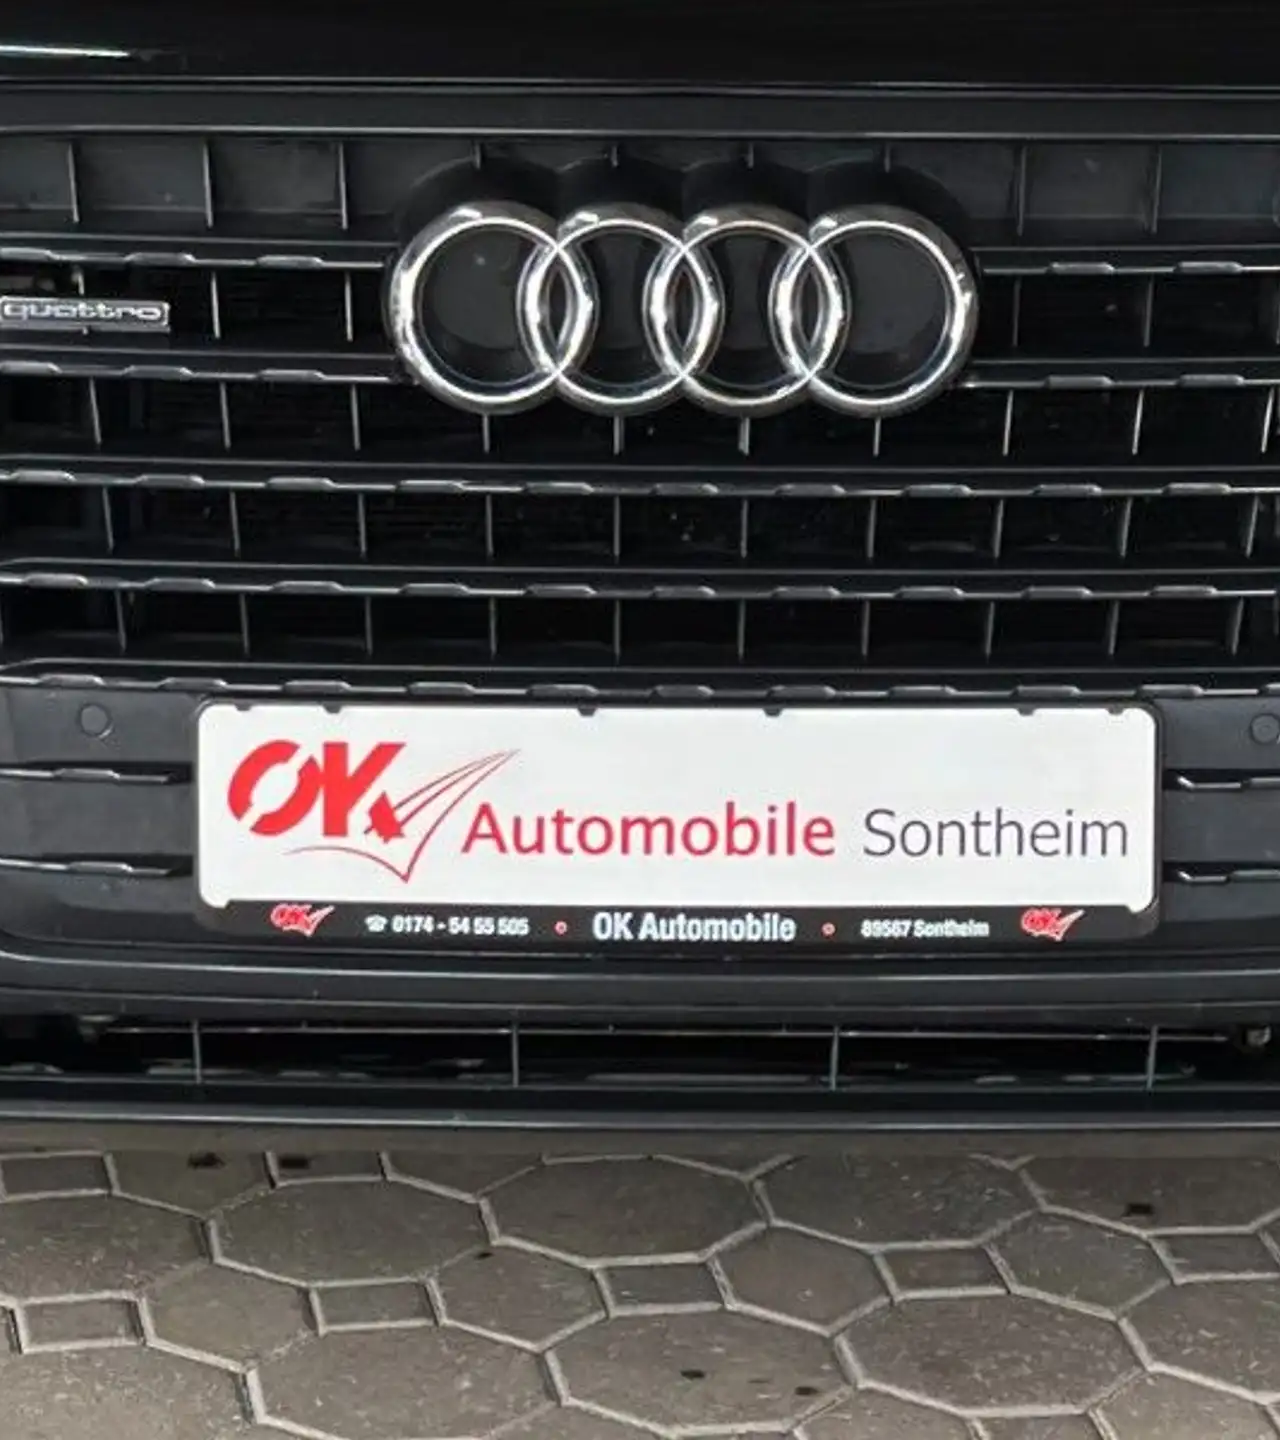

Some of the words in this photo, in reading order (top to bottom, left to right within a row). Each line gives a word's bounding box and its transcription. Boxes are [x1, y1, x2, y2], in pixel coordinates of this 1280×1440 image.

[3, 302, 162, 322] quattro
[227, 739, 406, 844] OK
[460, 801, 836, 857] Automobile
[863, 807, 1128, 858] Sontheim
[392, 915, 434, 933] 0174
[448, 916, 470, 935] 54
[474, 916, 495, 935] 55
[498, 916, 530, 936] 505
[592, 912, 634, 940] OK
[638, 912, 797, 942] Automobile
[913, 918, 990, 938] Sontheim
